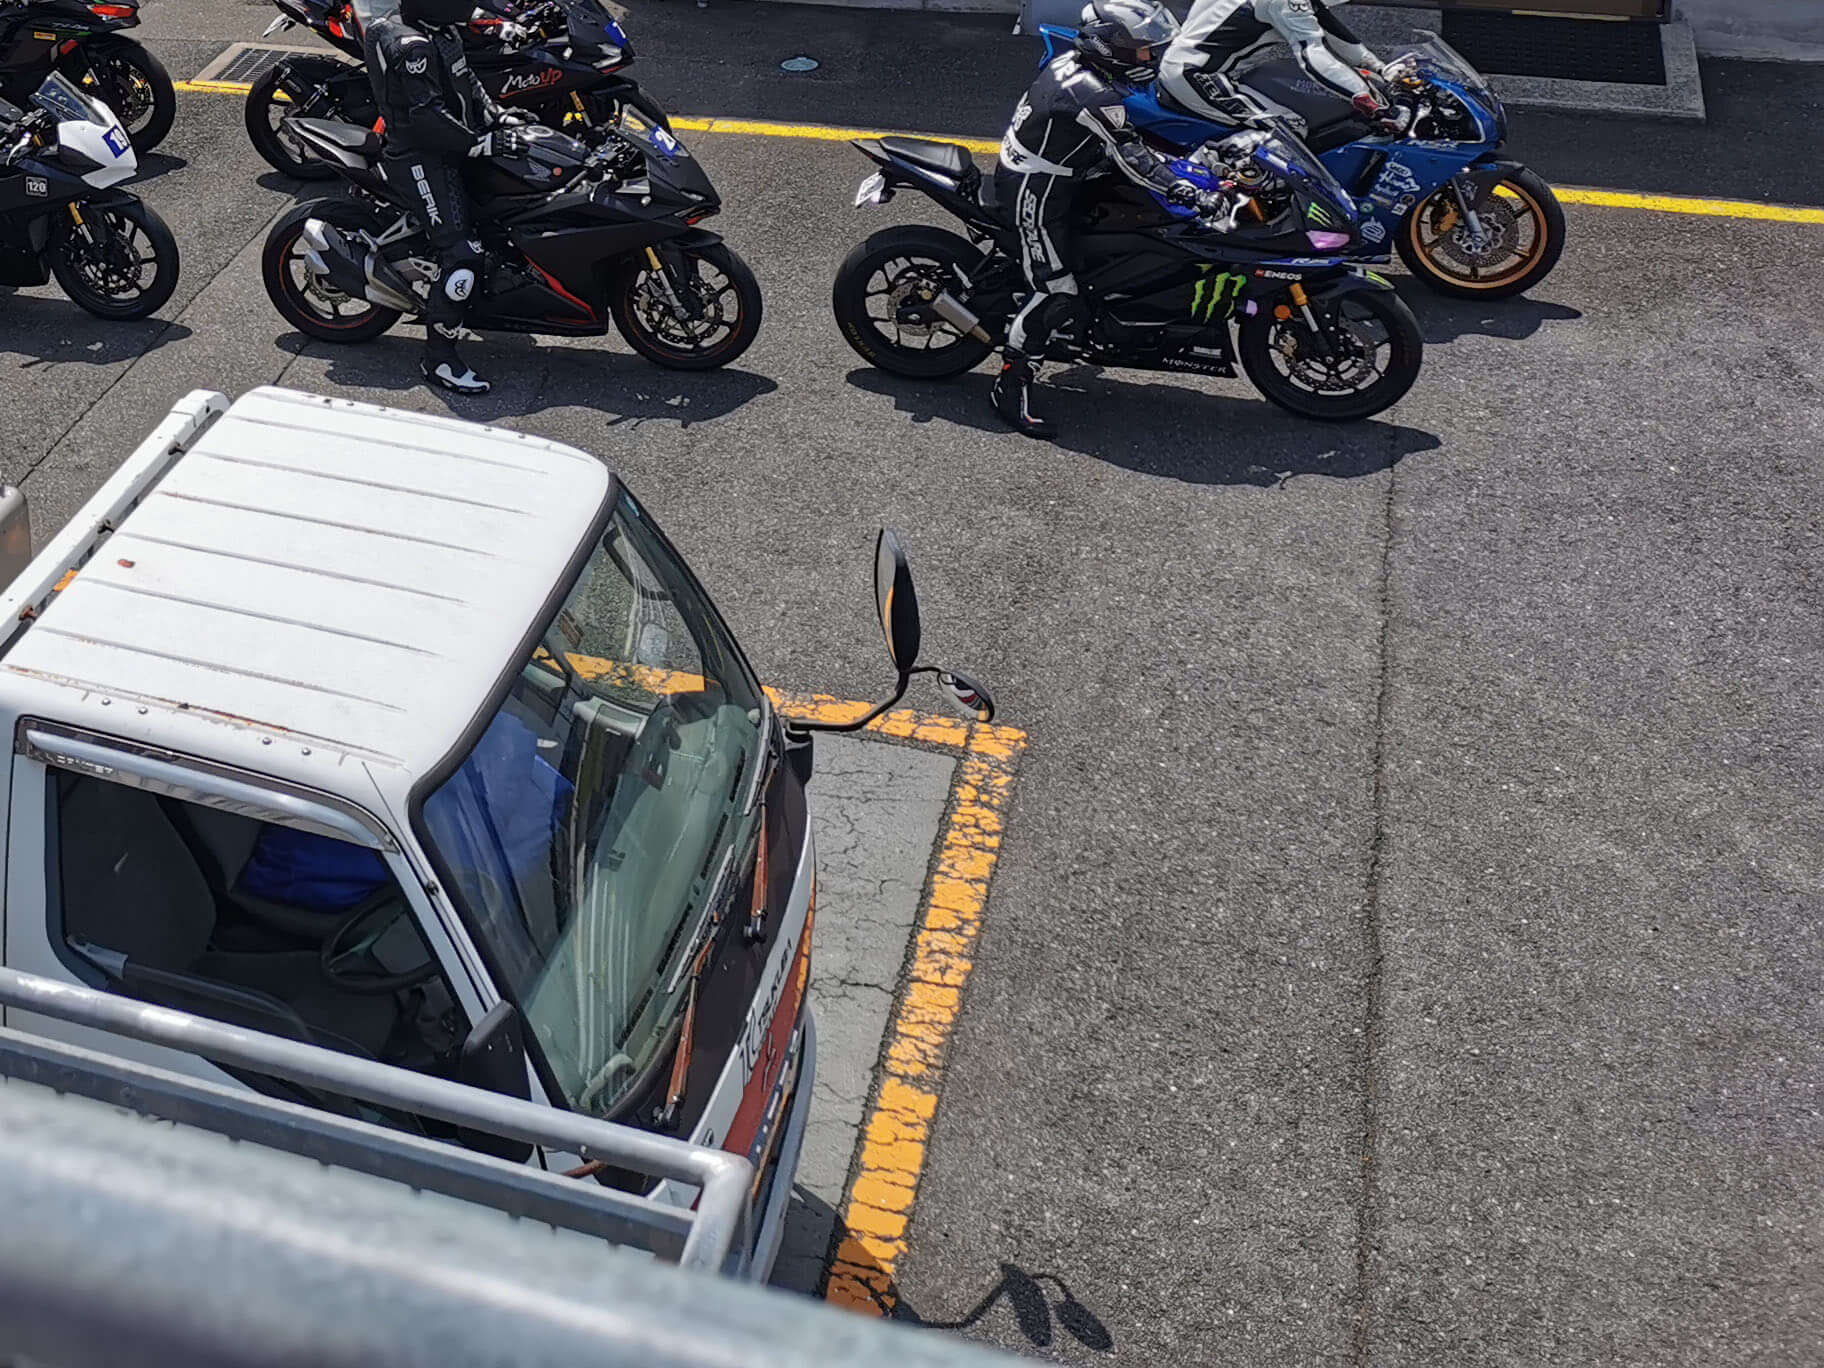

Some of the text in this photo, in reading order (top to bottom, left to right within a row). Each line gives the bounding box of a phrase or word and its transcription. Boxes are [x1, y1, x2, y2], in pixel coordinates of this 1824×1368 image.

[499, 67, 564, 95] MotoUP
[26, 180, 47, 193] 120
[410, 163, 444, 227] BERIK
[1263, 269, 1303, 281] ENEOS
[1161, 355, 1227, 375] MONSTER
